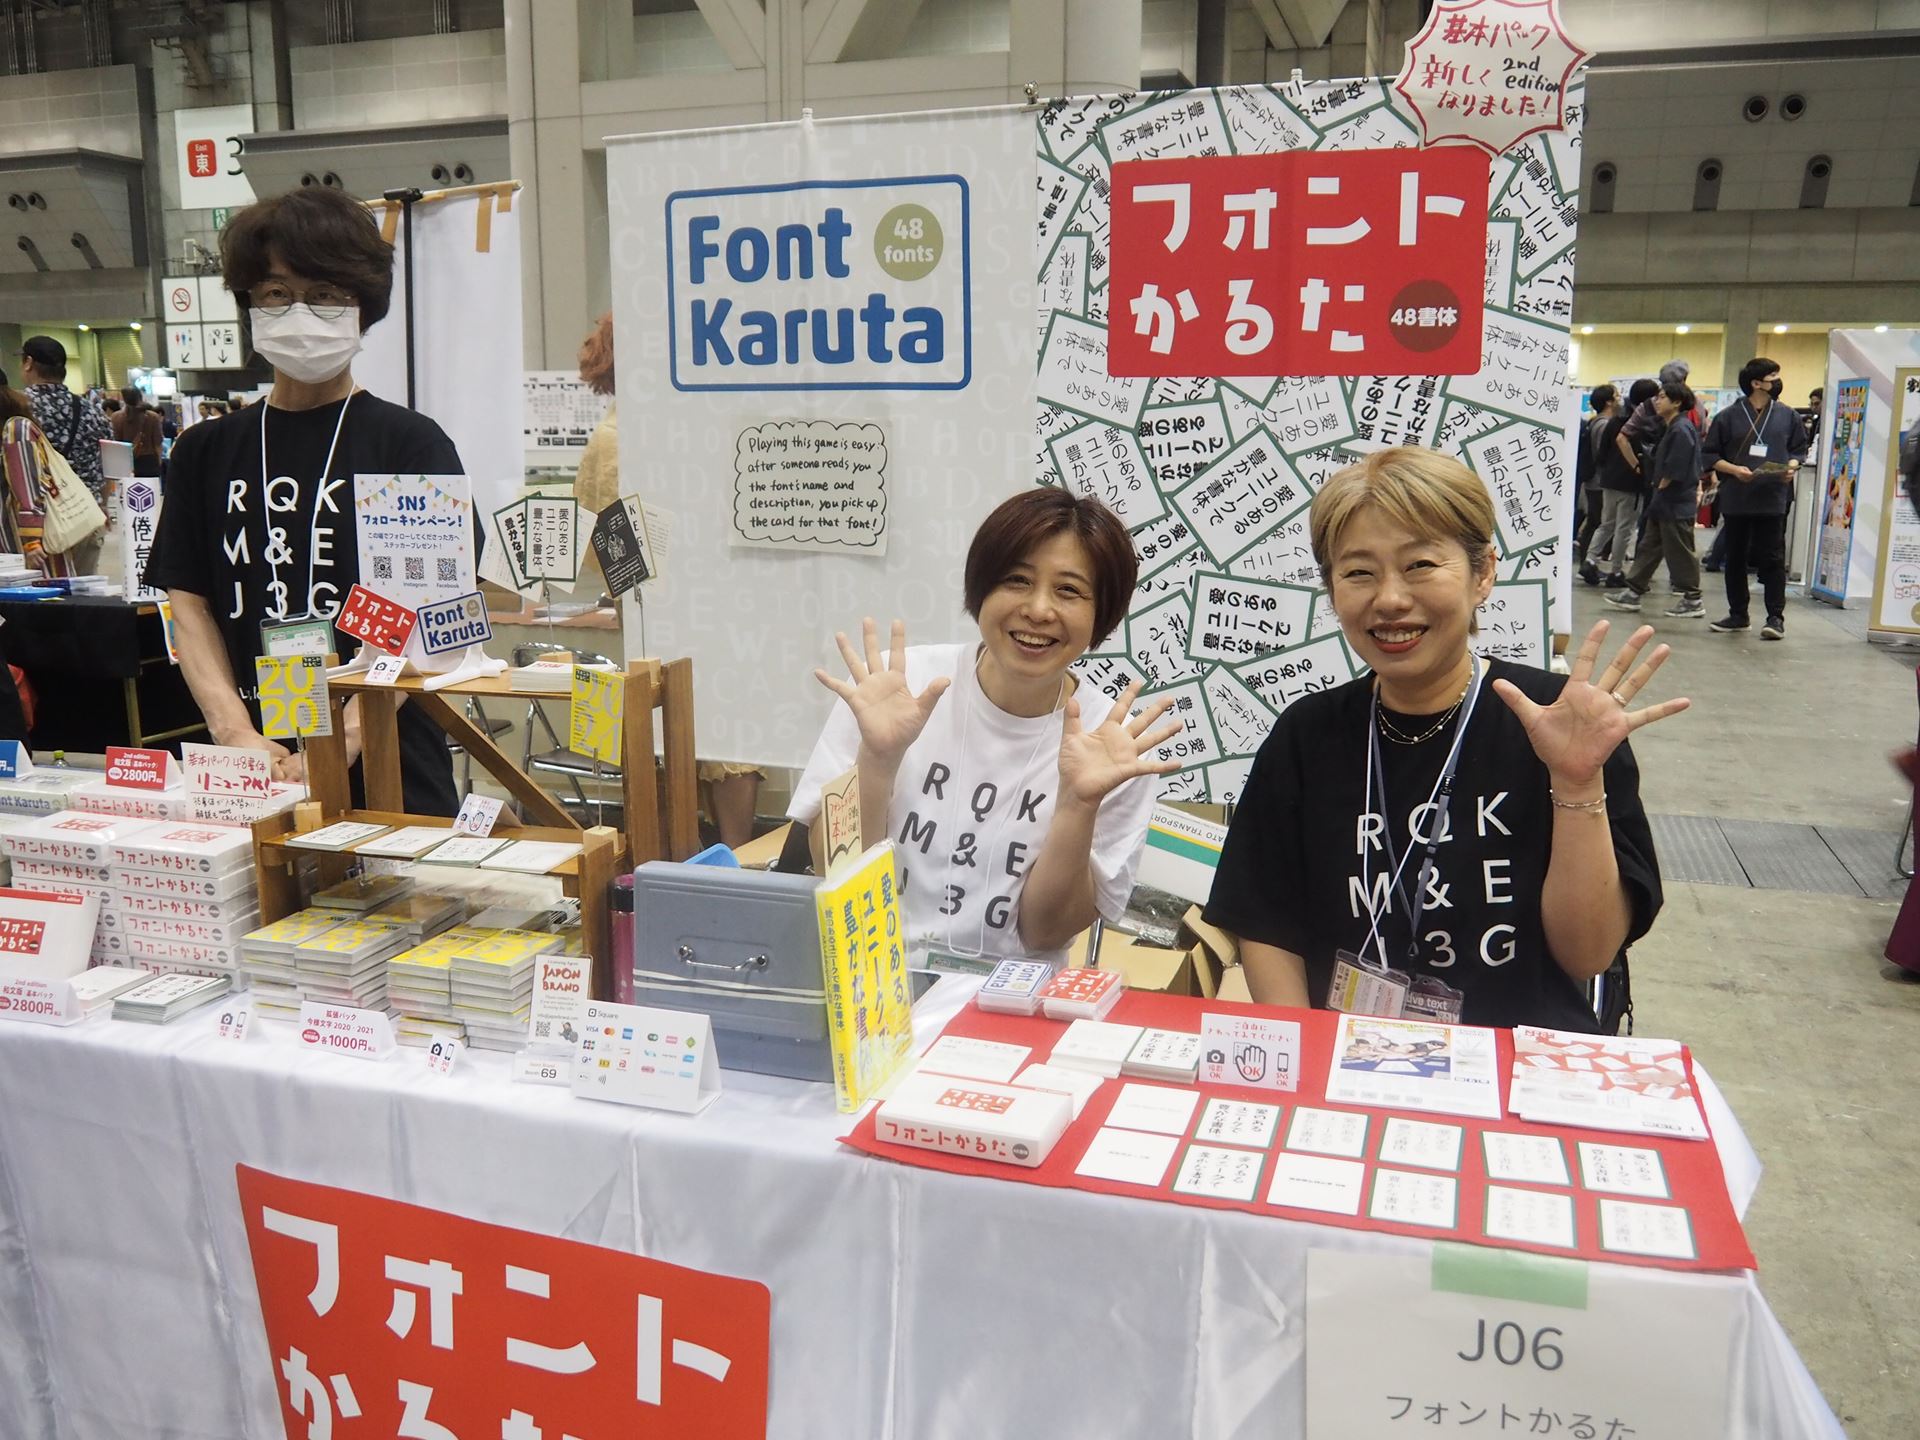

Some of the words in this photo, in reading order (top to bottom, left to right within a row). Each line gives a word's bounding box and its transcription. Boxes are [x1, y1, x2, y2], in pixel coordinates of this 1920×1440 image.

[1442, 13, 1550, 50] 基本パック
[1420, 54, 1491, 89] 新しく
[1502, 55, 1541, 72] 2nd
[1505, 74, 1562, 94] edition
[1437, 90, 1552, 118] なりました!
[1117, 102, 1205, 151] 豊かな書体。
[195, 153, 210, 173] 東
[226, 136, 244, 176] 3
[1132, 172, 1465, 254] フォント
[893, 217, 925, 241] 48
[688, 207, 852, 285] Font
[883, 243, 935, 265] fonts
[1129, 278, 1365, 356] かるた
[1390, 306, 1458, 329] 48書体
[691, 292, 944, 367] Karuta
[1066, 382, 1130, 414] 愛のある
[1485, 379, 1560, 413] 愛のある
[1138, 415, 1206, 437] 愛のある
[748, 436, 788, 453] Playing
[792, 435, 811, 449] this
[814, 438, 838, 453] game
[840, 438, 849, 450] is
[747, 459, 776, 473] after
[780, 460, 820, 470] someone
[822, 457, 850, 470] reads
[852, 462, 872, 474] you
[1104, 427, 1142, 492] 愛のある
[748, 481, 767, 492] the
[770, 479, 800, 491] font's
[802, 481, 829, 491] name
[834, 480, 855, 491] and
[1086, 437, 1129, 517] ユニークで
[1190, 446, 1268, 516] 豊かな書体。
[1507, 438, 1552, 521] ユニークで
[227, 479, 248, 514] R
[265, 476, 299, 512] Q
[314, 478, 346, 513] K
[1209, 467, 1279, 527] ユニークで
[1482, 444, 1535, 538] 豊かな書体。
[397, 495, 426, 512] SNS
[628, 503, 637, 516] K
[749, 497, 814, 511] description,
[819, 500, 839, 511] you
[841, 497, 864, 512] pick
[866, 500, 879, 512] up
[1234, 484, 1296, 535] 愛のある
[362, 514, 463, 528] フォローキャンペーン!
[558, 508, 569, 557] 愛のある
[632, 520, 640, 532] E
[749, 516, 768, 527] the
[770, 516, 794, 527] card
[799, 515, 814, 528] for
[817, 517, 840, 527] that
[845, 516, 877, 531] font!
[223, 525, 251, 566] M
[264, 527, 294, 565] &
[313, 527, 334, 566] E
[545, 508, 556, 567] ユニークで
[229, 582, 244, 619] J
[264, 580, 289, 619] 3
[310, 581, 341, 620] G
[354, 590, 411, 629] フォント
[1209, 587, 1278, 612] 愛のある
[344, 611, 389, 645] かるた
[423, 604, 464, 628] Font
[1208, 611, 1291, 637] ユニークで
[428, 621, 486, 649] Karuta
[260, 656, 316, 696] 20
[1246, 658, 1313, 691] 愛のある
[262, 697, 319, 737] 20
[188, 752, 230, 768] 基本パック
[233, 756, 267, 773] 48書体
[122, 768, 157, 783] 2800円
[15, 796, 51, 809] Karuta
[922, 762, 951, 800] R
[970, 782, 998, 822] Q
[1016, 789, 1046, 822] K
[80, 796, 155, 814] フォントかるた
[1356, 813, 1385, 855] R
[1477, 792, 1513, 837] K
[7, 839, 83, 859] フォントかるた
[899, 811, 937, 854] M
[952, 832, 978, 868] &
[1005, 841, 1027, 878] E
[17, 861, 96, 880] フォントかるた
[116, 850, 196, 870] フォントかるた
[121, 873, 201, 894] フォントかるた
[1348, 872, 1392, 918] M
[1414, 866, 1454, 911] &
[1483, 859, 1513, 904] E
[123, 896, 205, 917] フォントかるた
[939, 884, 966, 915] 3
[984, 896, 1011, 929] G
[1, 921, 42, 935] フォント
[129, 917, 209, 940] フォントかるた
[134, 940, 214, 962] フォントかるた
[1424, 930, 1457, 968] 3
[1479, 924, 1517, 967] G
[28, 980, 48, 988] edition
[543, 964, 581, 980] JAPON
[989, 961, 1017, 989] Karuta
[1017, 963, 1042, 983] Font
[543, 982, 580, 993] BRAND
[1069, 971, 1105, 1001] フォント
[12, 998, 54, 1015] 2800円
[325, 1009, 357, 1021] 拡張パック
[598, 1010, 619, 1019] Square
[1426, 997, 1448, 1010] text
[1207, 1027, 1294, 1043] さわってみてください
[1235, 1021, 1267, 1032] ご自由に
[321, 1034, 368, 1051] 各1000円
[541, 1068, 557, 1079] 69
[1242, 1064, 1261, 1077] OK
[1276, 1072, 1289, 1080] SNS
[1276, 1079, 1288, 1087] OK
[943, 1097, 989, 1111] かるた
[950, 1089, 1010, 1105] フォント
[885, 1121, 1007, 1157] フォントかるた
[262, 1205, 731, 1406] フォント
[1457, 1318, 1564, 1372] J06
[1386, 1395, 1637, 1440] フォントかるた
